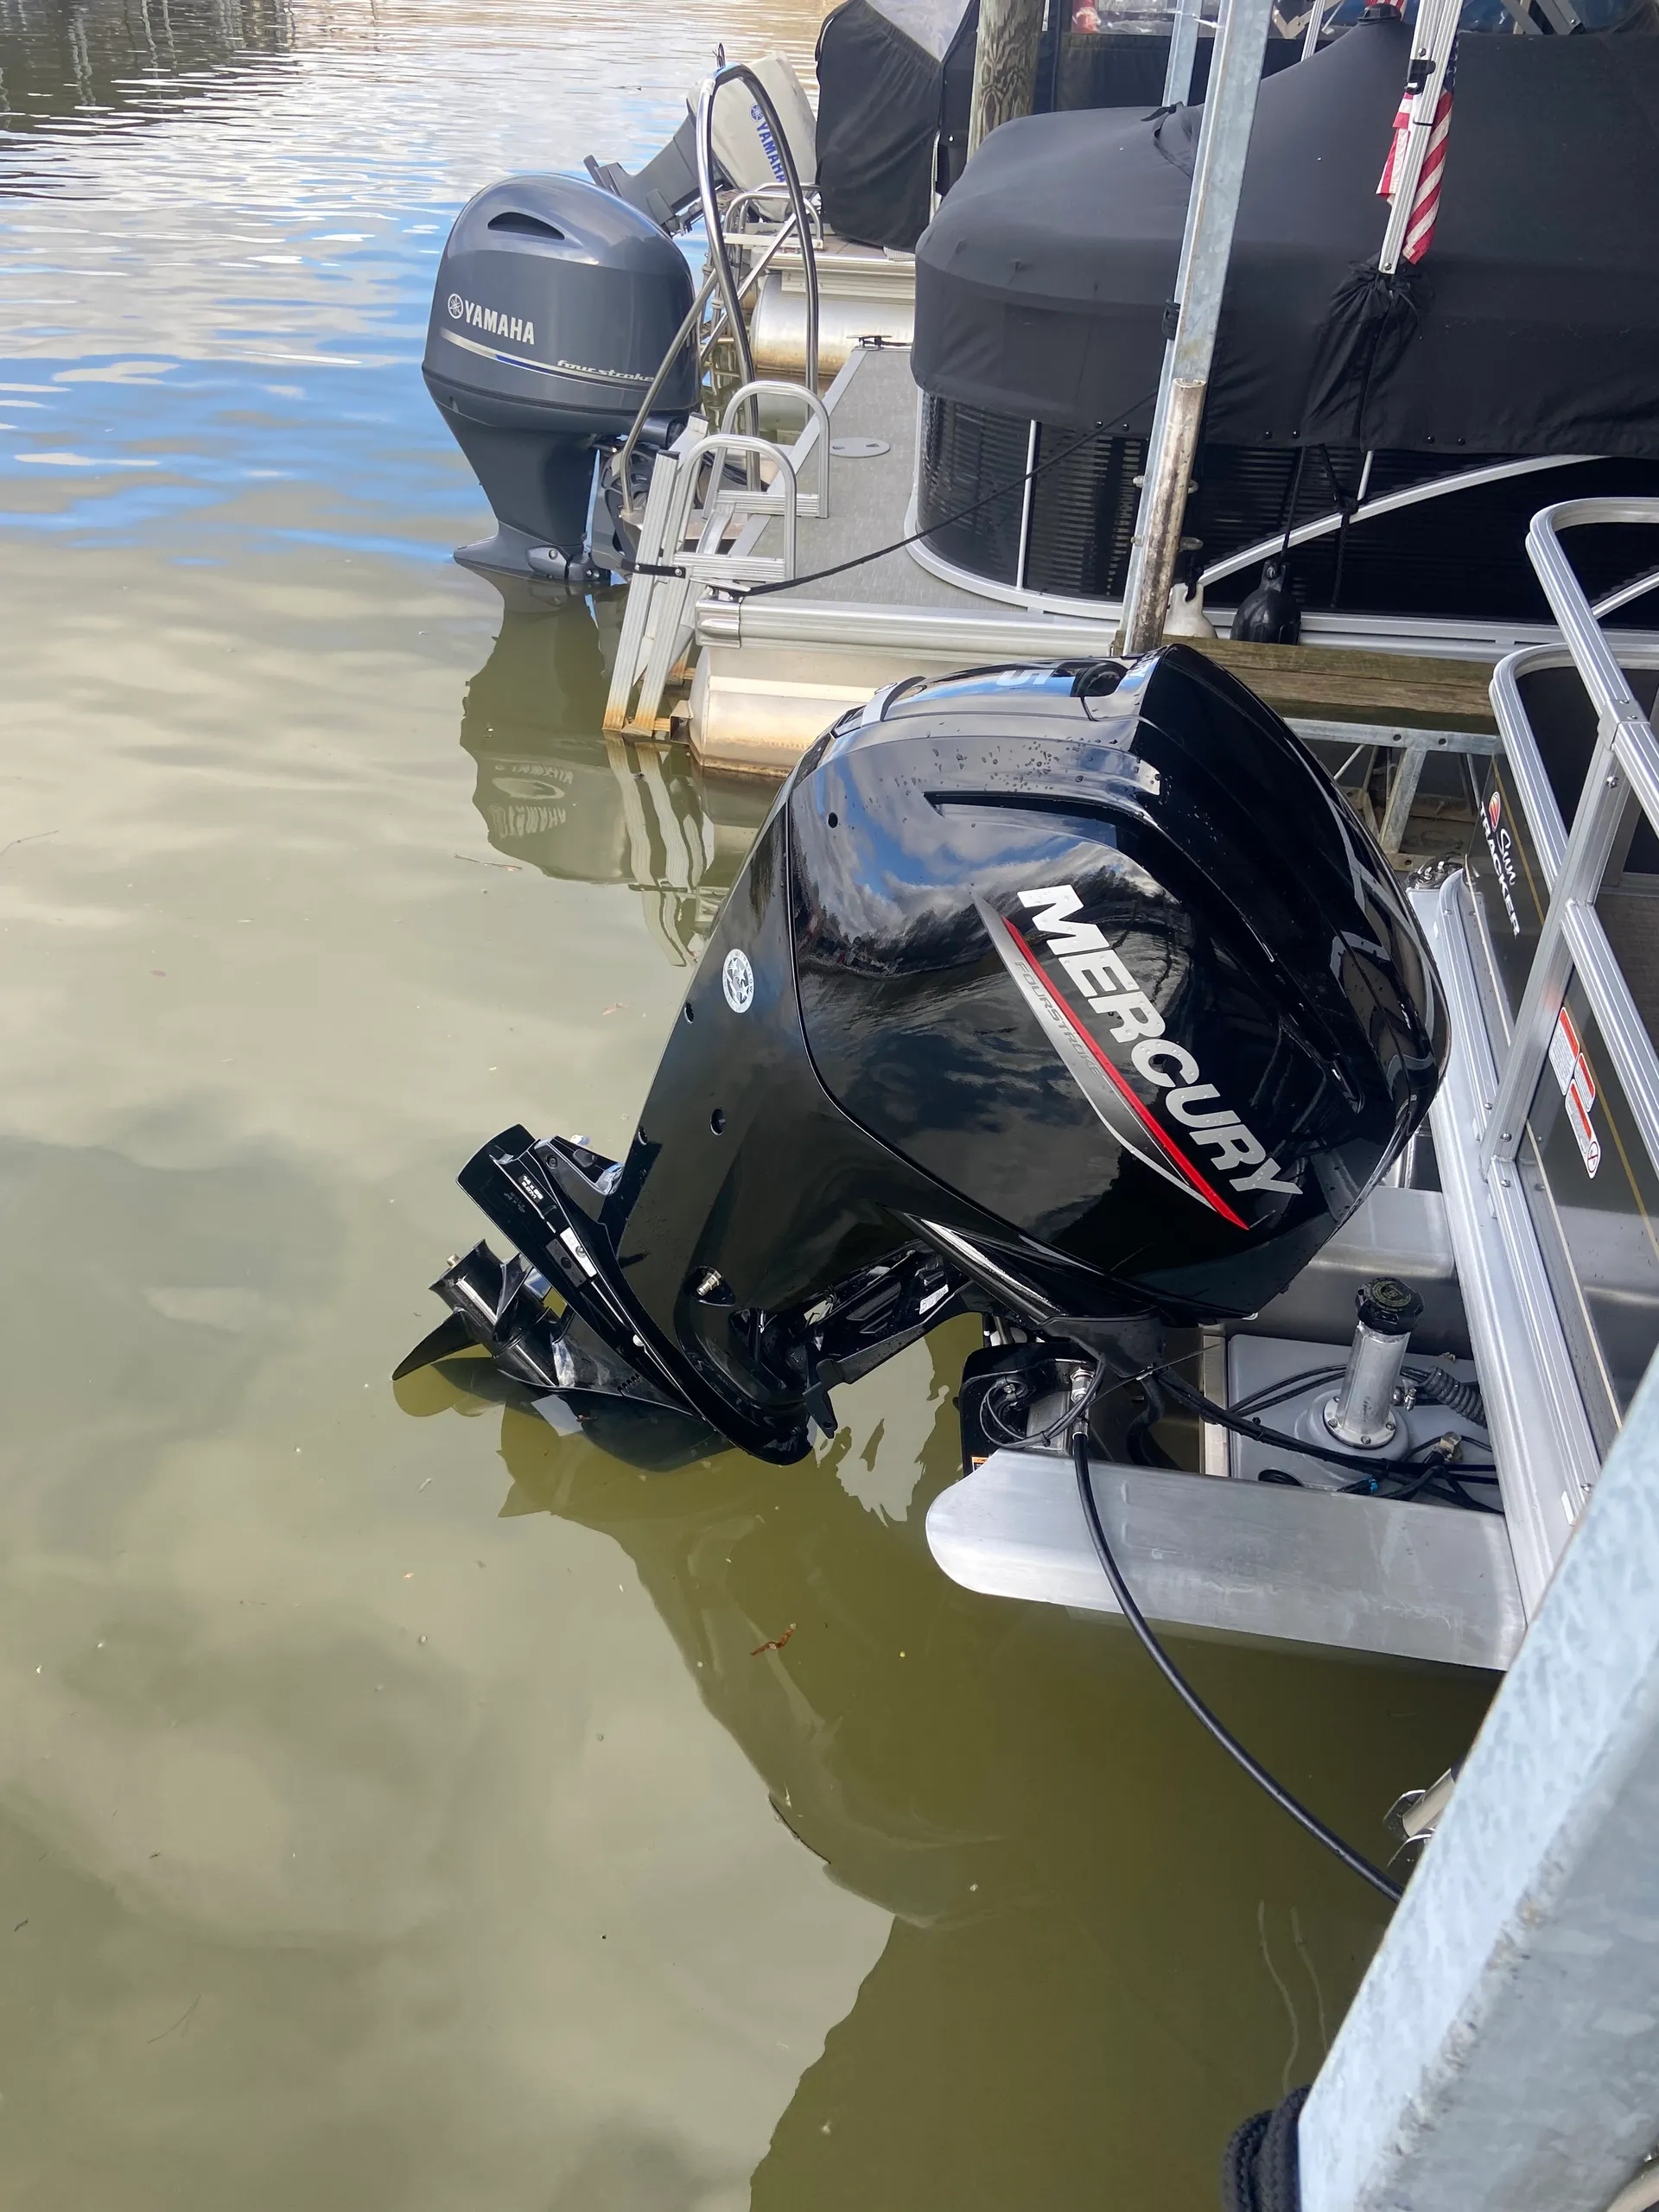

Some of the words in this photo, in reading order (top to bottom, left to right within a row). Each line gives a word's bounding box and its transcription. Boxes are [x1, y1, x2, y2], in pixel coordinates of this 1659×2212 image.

[464, 300, 535, 345] YAMAHA
[1480, 801, 1521, 938] TRACKER
[1496, 828, 1516, 885] Sun
[1014, 960, 1103, 1077] FOURSTROKE
[1017, 884, 1303, 1195] MERCURY
